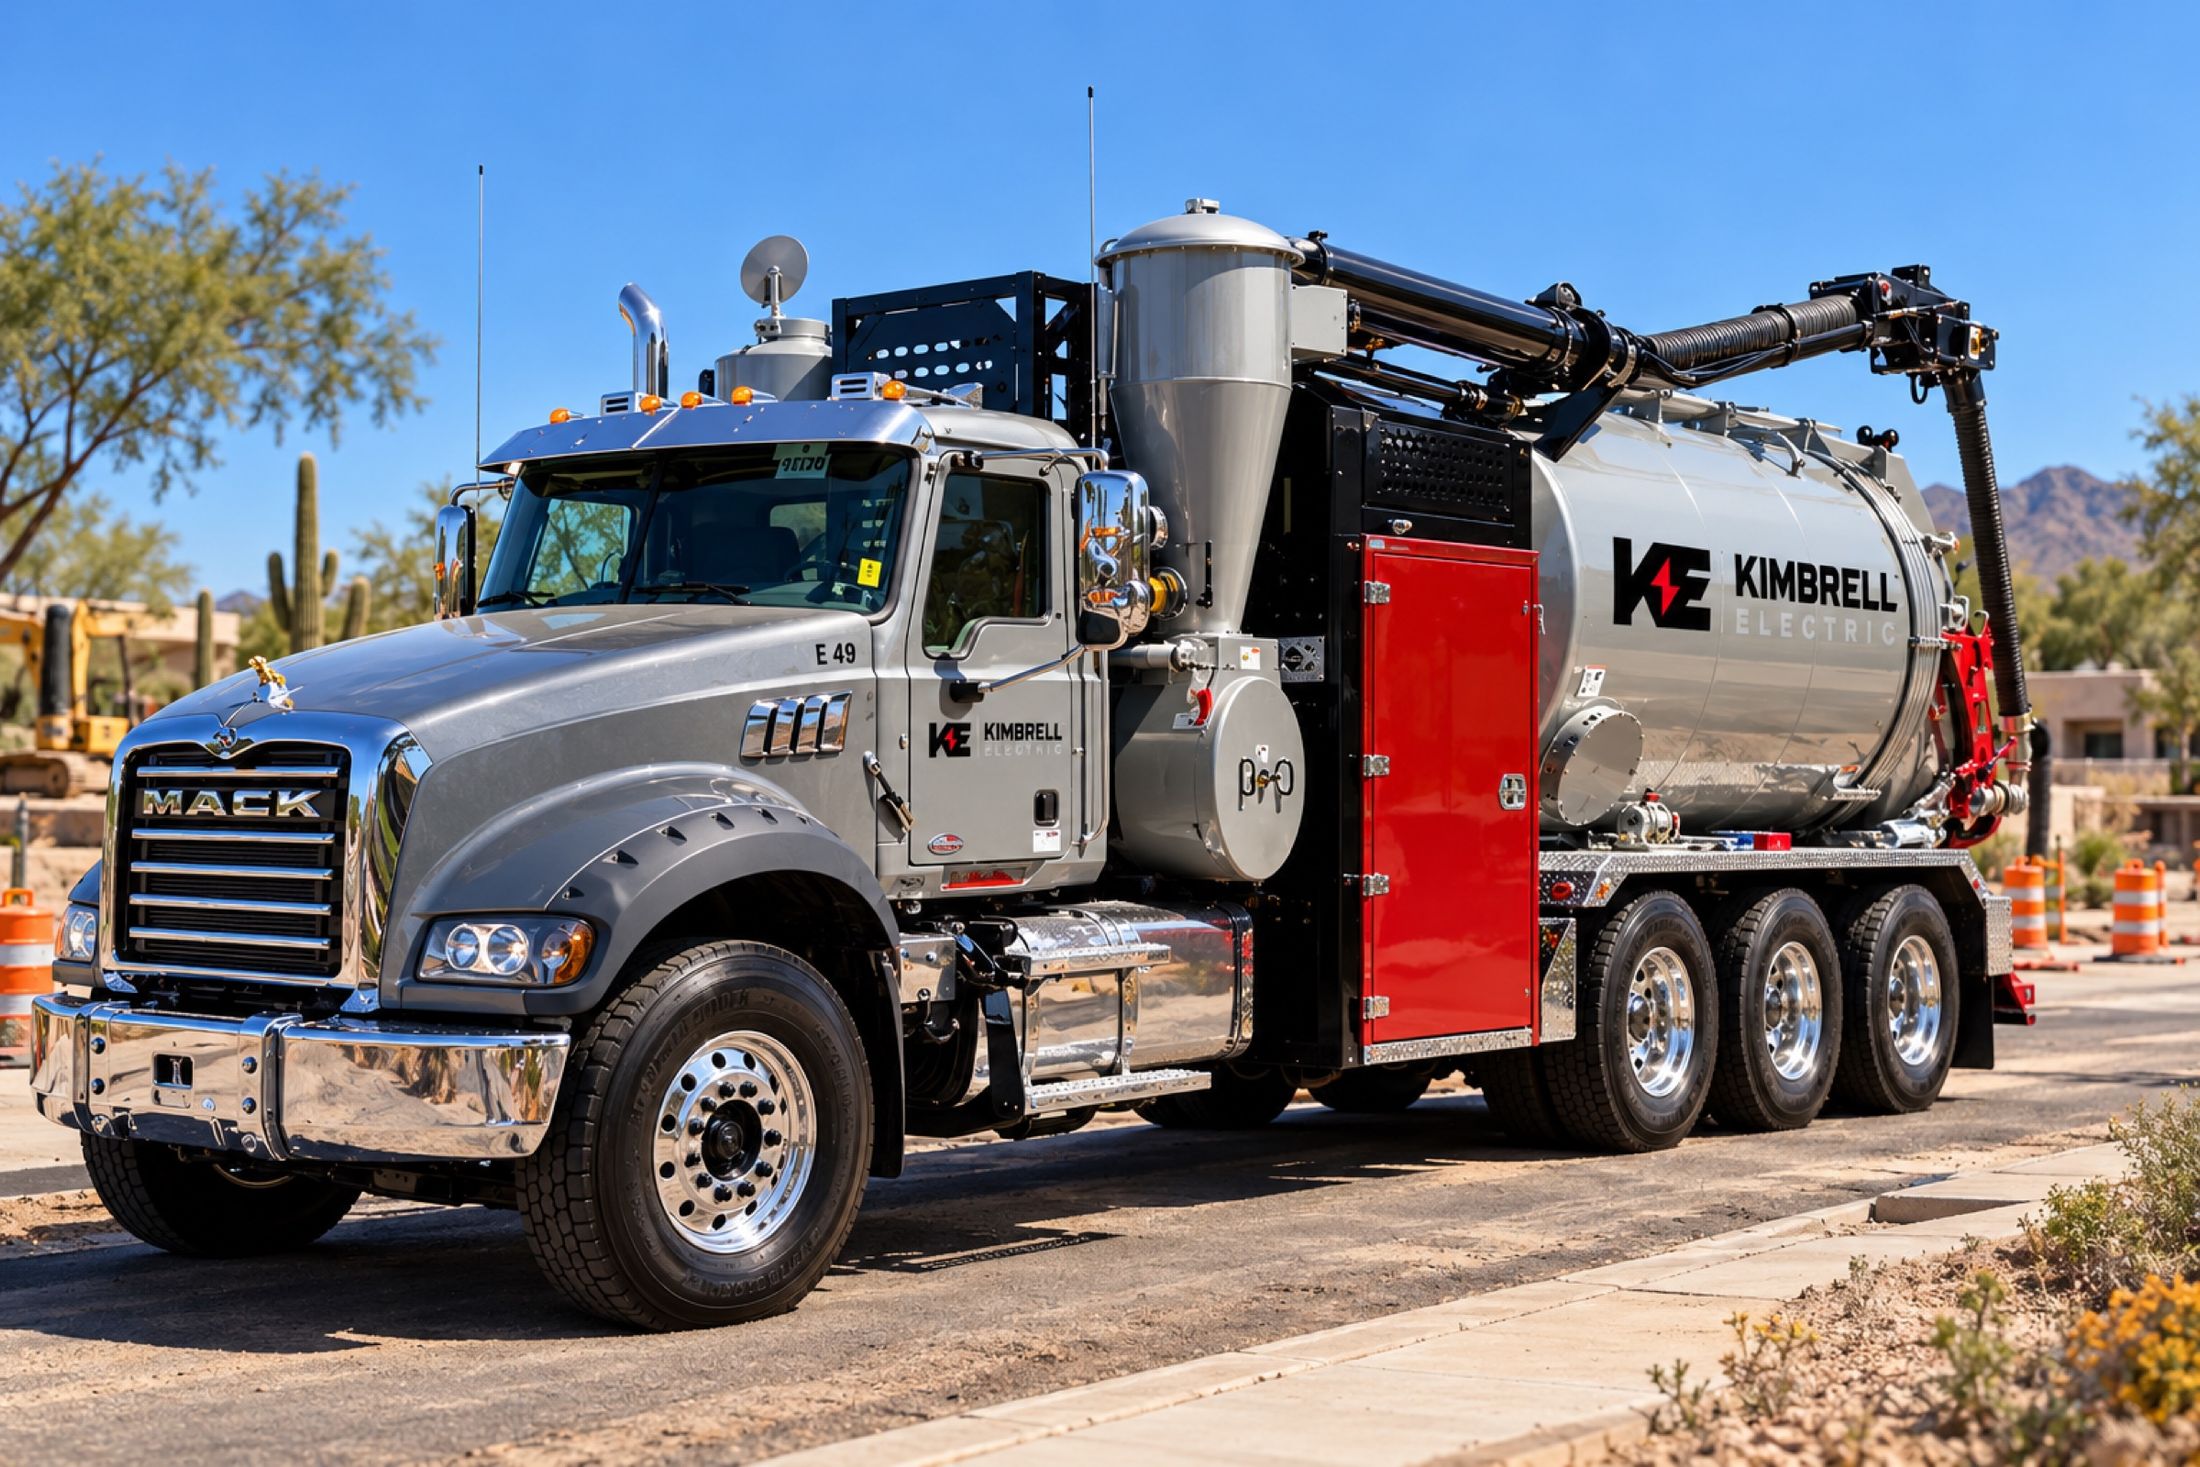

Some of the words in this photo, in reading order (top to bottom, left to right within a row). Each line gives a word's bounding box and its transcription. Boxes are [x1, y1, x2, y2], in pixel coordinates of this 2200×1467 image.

[1734, 553, 1898, 612] KIMBRELL
[1736, 608, 1896, 646] ELECTRIC
[815, 644, 828, 665] E
[833, 642, 856, 664] 49
[984, 722, 1062, 741] KIMBRELL
[143, 789, 321, 818] MACK
